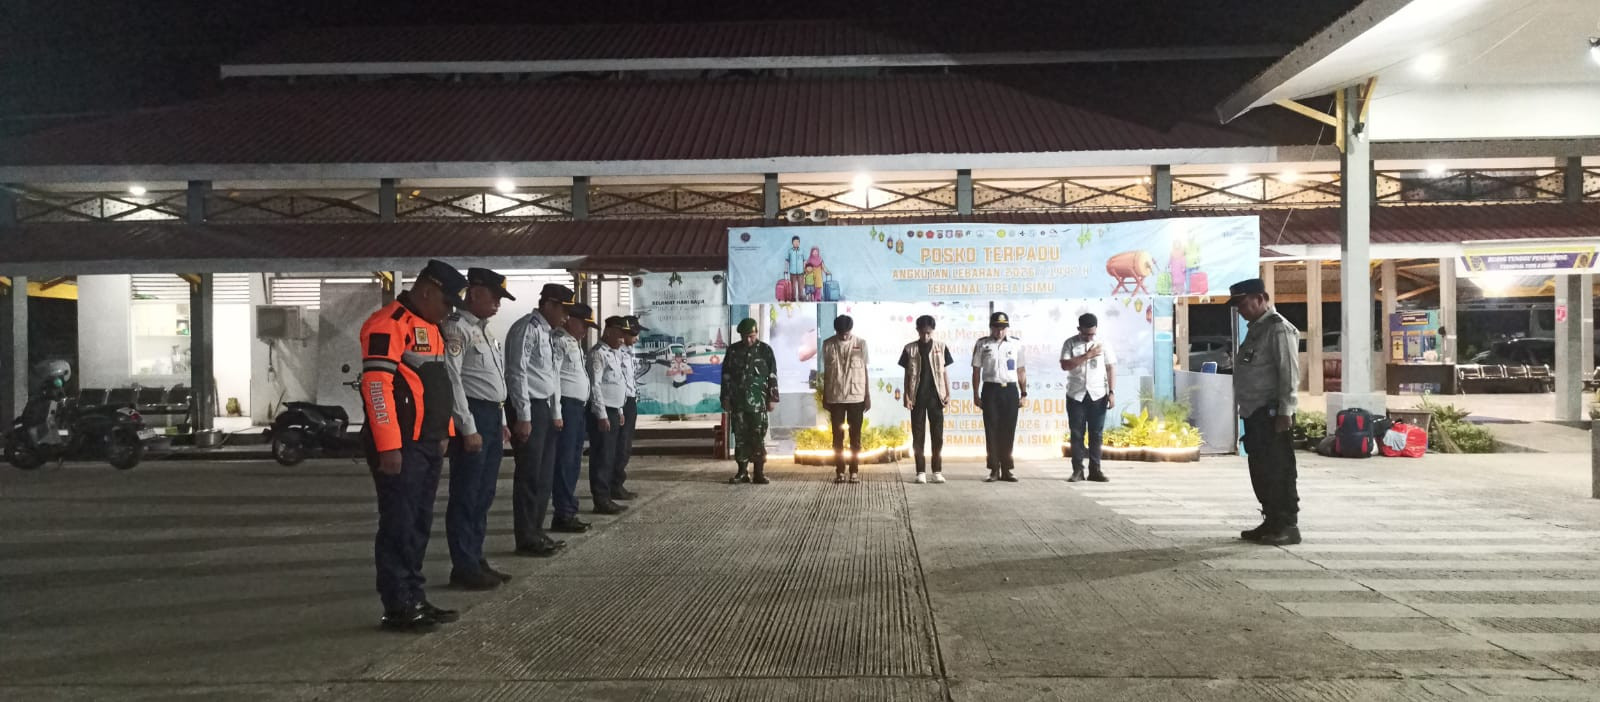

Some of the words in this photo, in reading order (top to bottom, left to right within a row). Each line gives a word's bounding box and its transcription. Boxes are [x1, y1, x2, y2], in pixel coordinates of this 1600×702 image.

[920, 247, 977, 264] POSKO
[984, 246, 1061, 262] TERPADU
[892, 268, 949, 280] ANGKUTAN
[952, 267, 1001, 279] LEBARAN
[928, 283, 982, 295] TERMINAL
[1023, 282, 1056, 294] ISIMU
